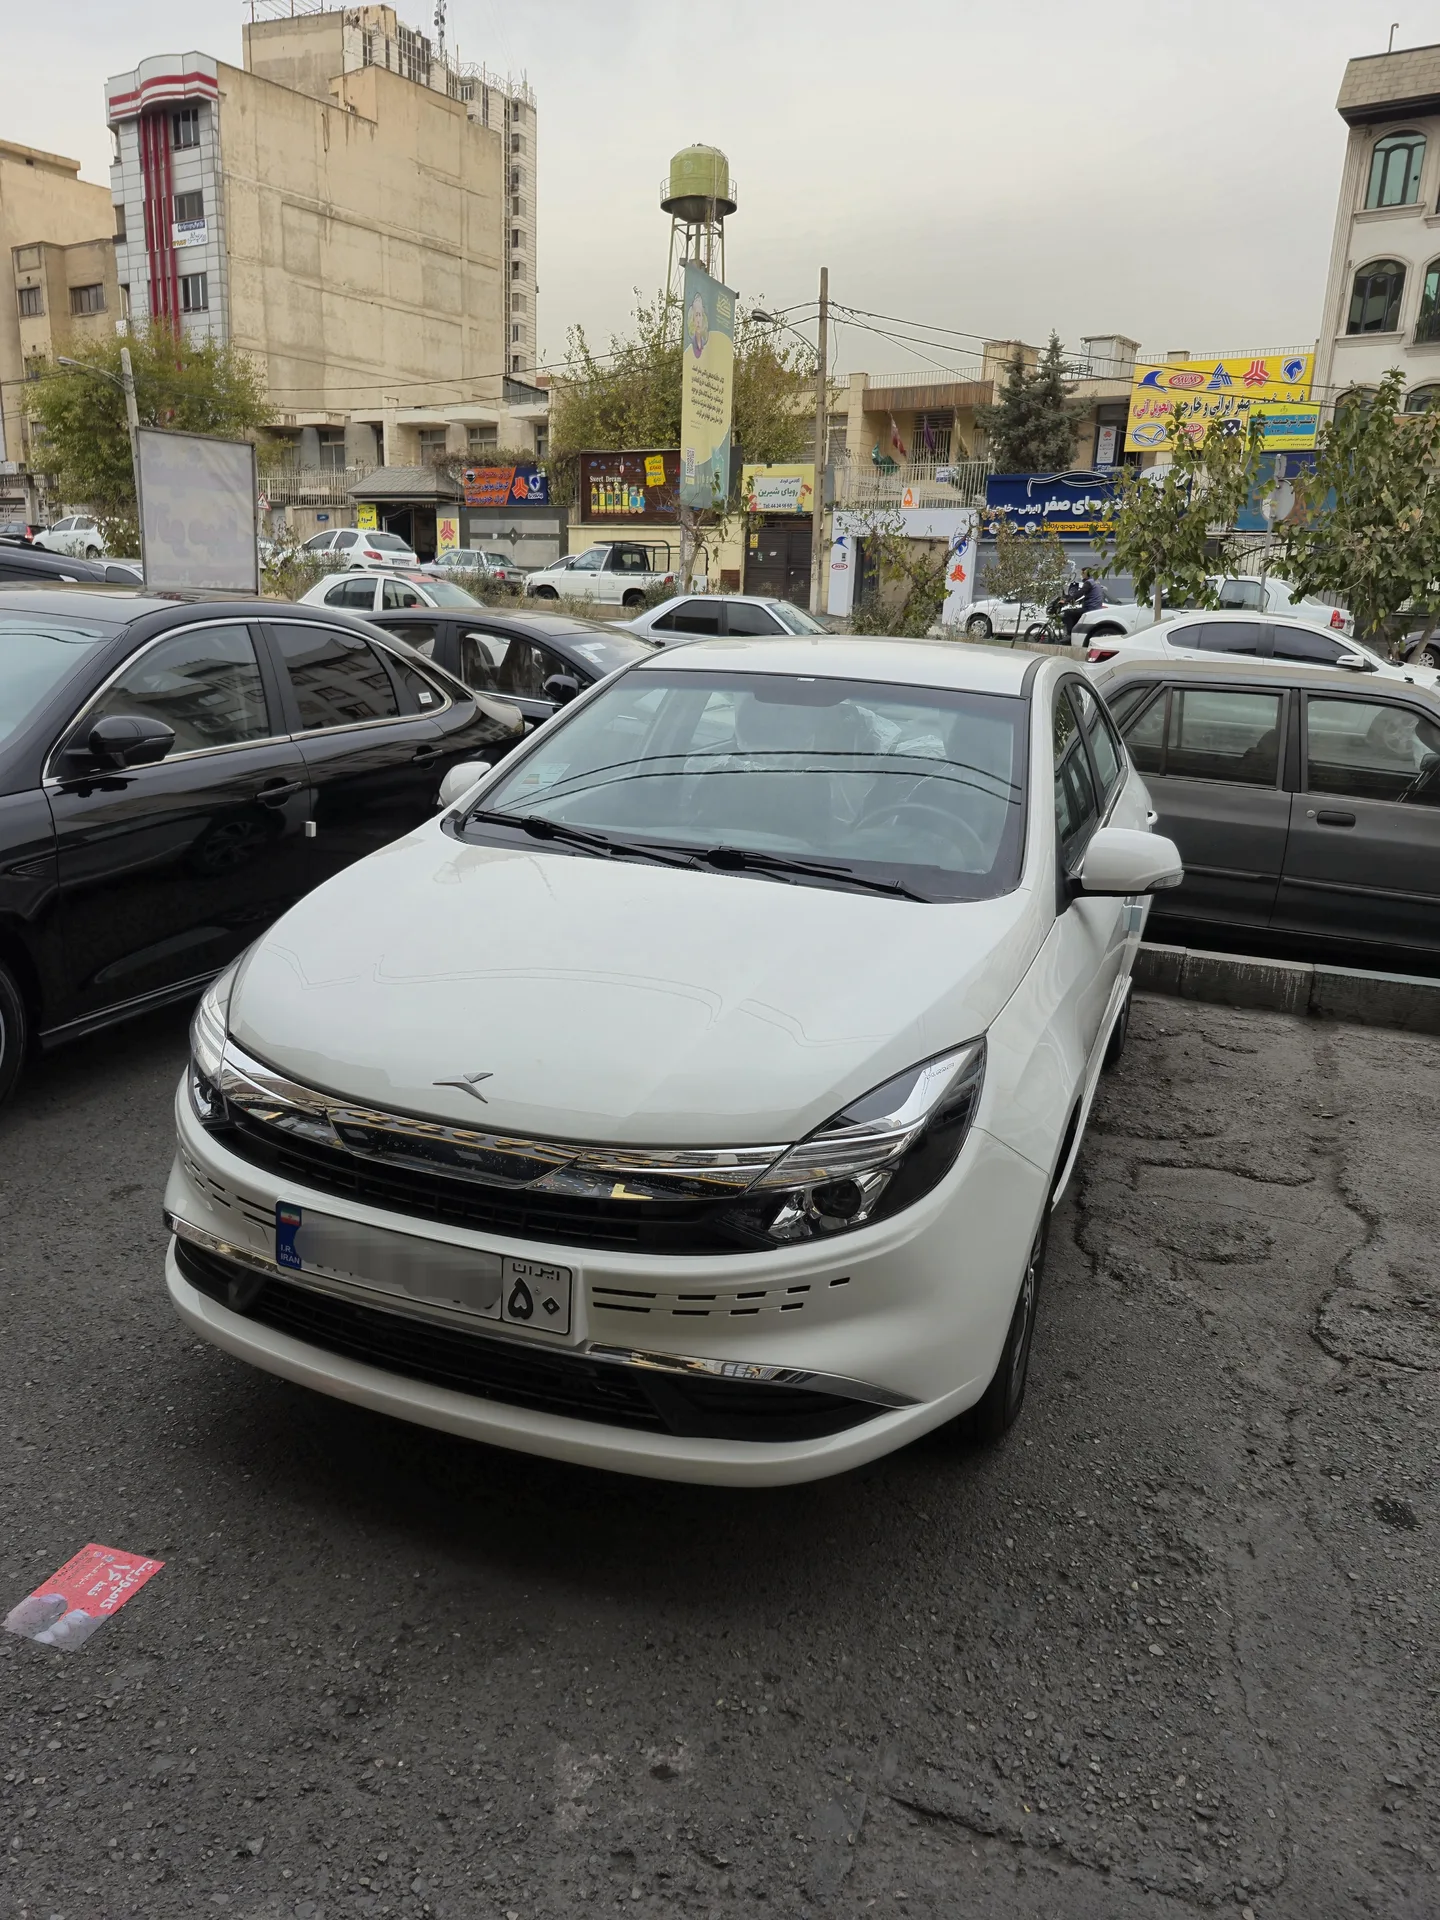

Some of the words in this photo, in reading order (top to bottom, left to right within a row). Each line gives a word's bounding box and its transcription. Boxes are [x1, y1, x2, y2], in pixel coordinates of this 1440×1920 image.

[1180, 396, 1203, 418] خارج
[1210, 395, 1234, 417] ایرانی
[758, 487, 780, 497] شیرین
[781, 488, 798, 497] رویای
[1043, 496, 1071, 516] صفر
[280, 1253, 300, 1265] IRAN
[513, 1263, 560, 1281] ایران
[87, 1580, 107, 1596] فقط
[100, 1560, 153, 1610] کامپوزیت
